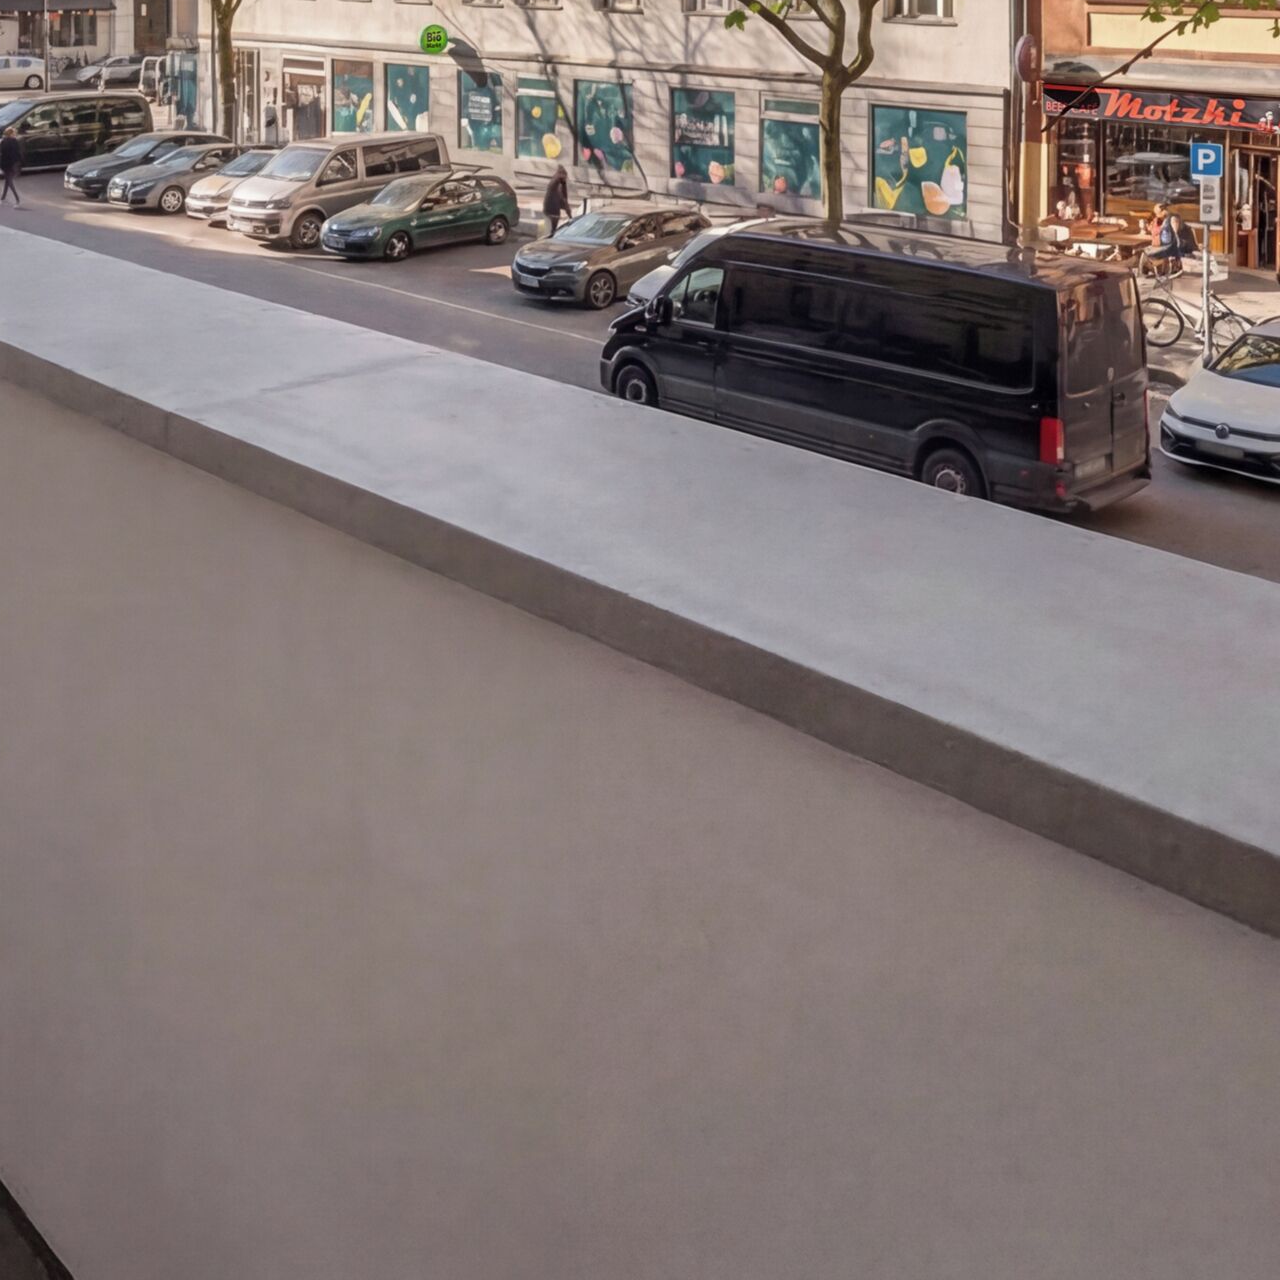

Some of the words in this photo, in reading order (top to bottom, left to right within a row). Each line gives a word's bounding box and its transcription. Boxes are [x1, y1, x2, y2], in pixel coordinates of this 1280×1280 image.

[1045, 100, 1066, 113] BEE
[1094, 87, 1266, 132] Motzki
[1197, 148, 1216, 171] P
